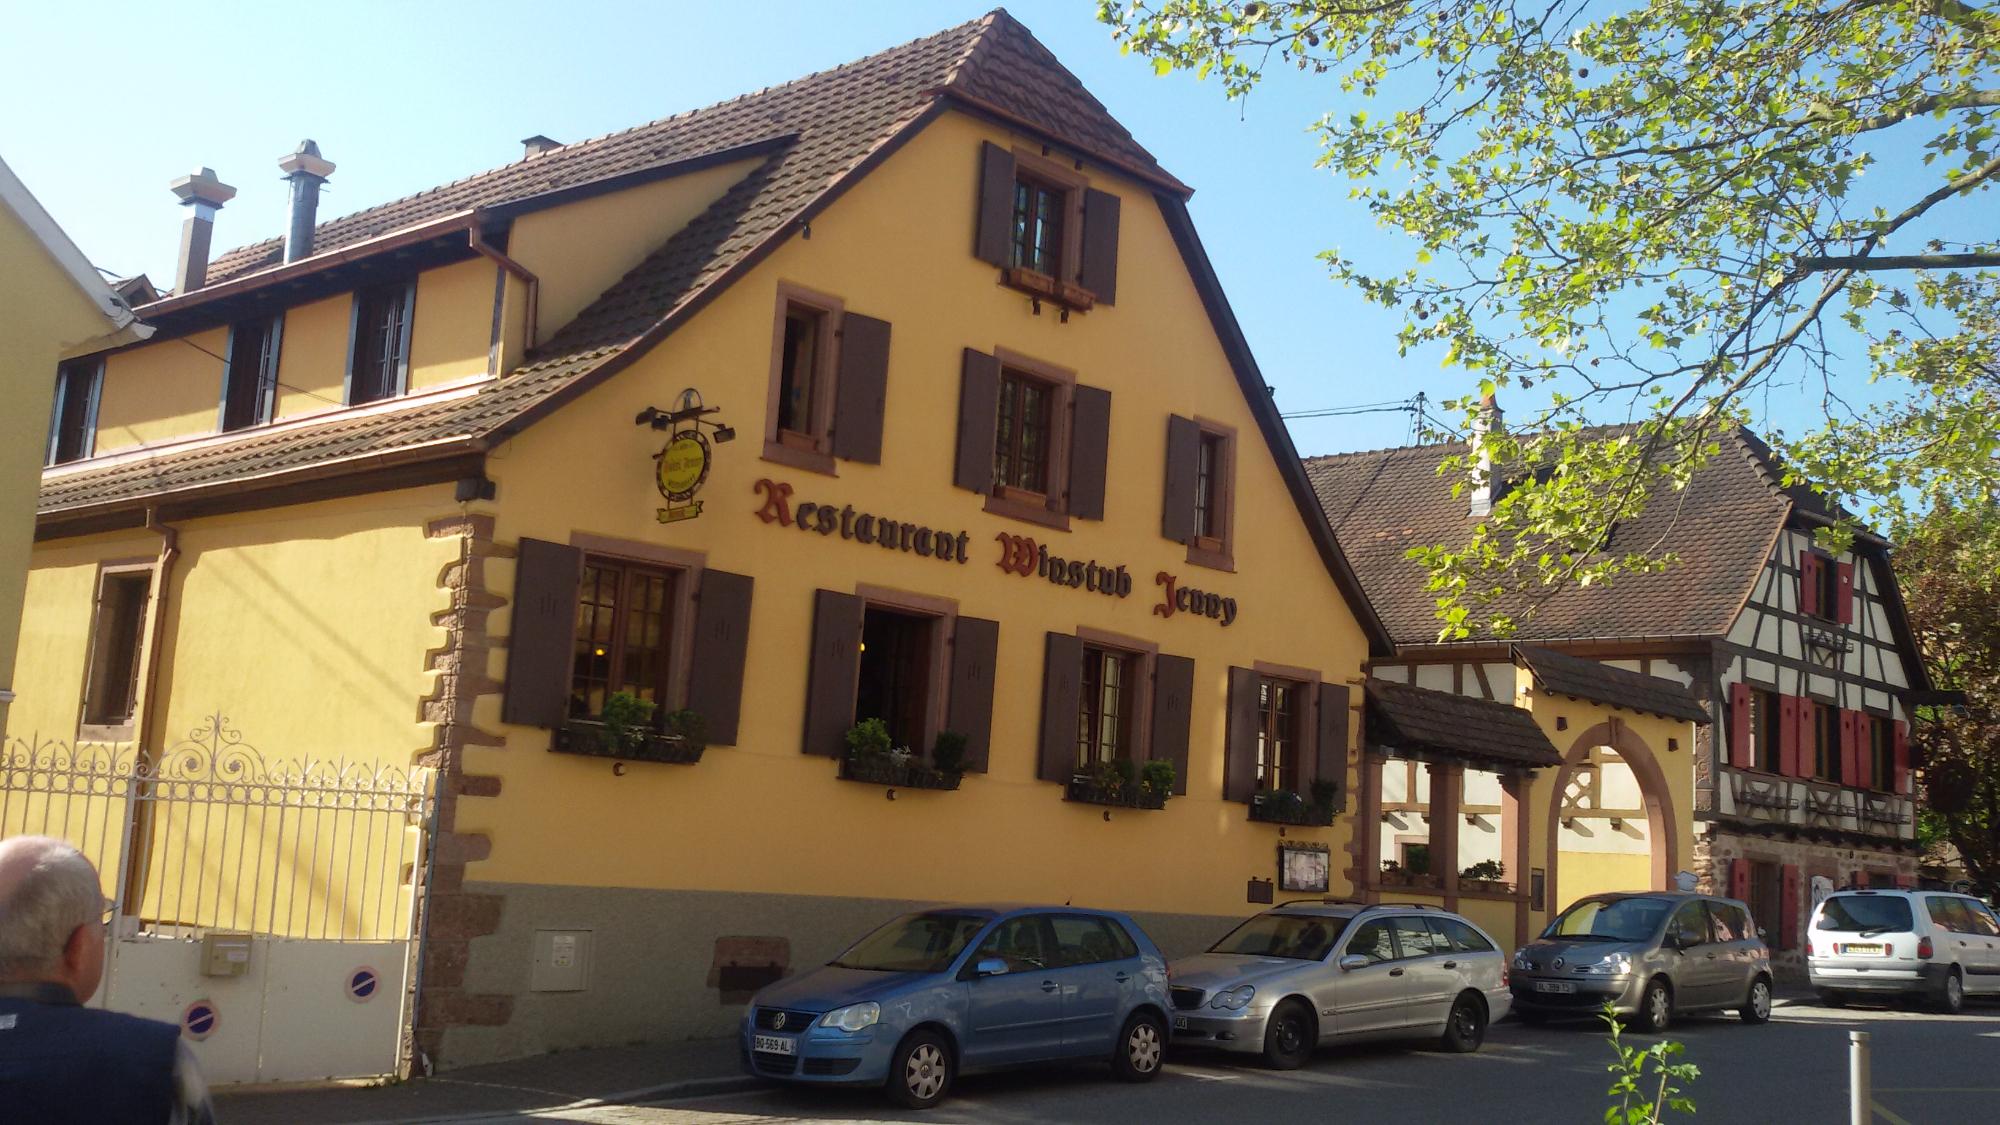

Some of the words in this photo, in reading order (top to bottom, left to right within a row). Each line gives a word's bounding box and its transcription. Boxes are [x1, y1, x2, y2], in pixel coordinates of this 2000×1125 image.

[754, 478, 970, 564] Restaurant
[995, 532, 1132, 599] Winstub
[1153, 571, 1238, 627] Jenny
